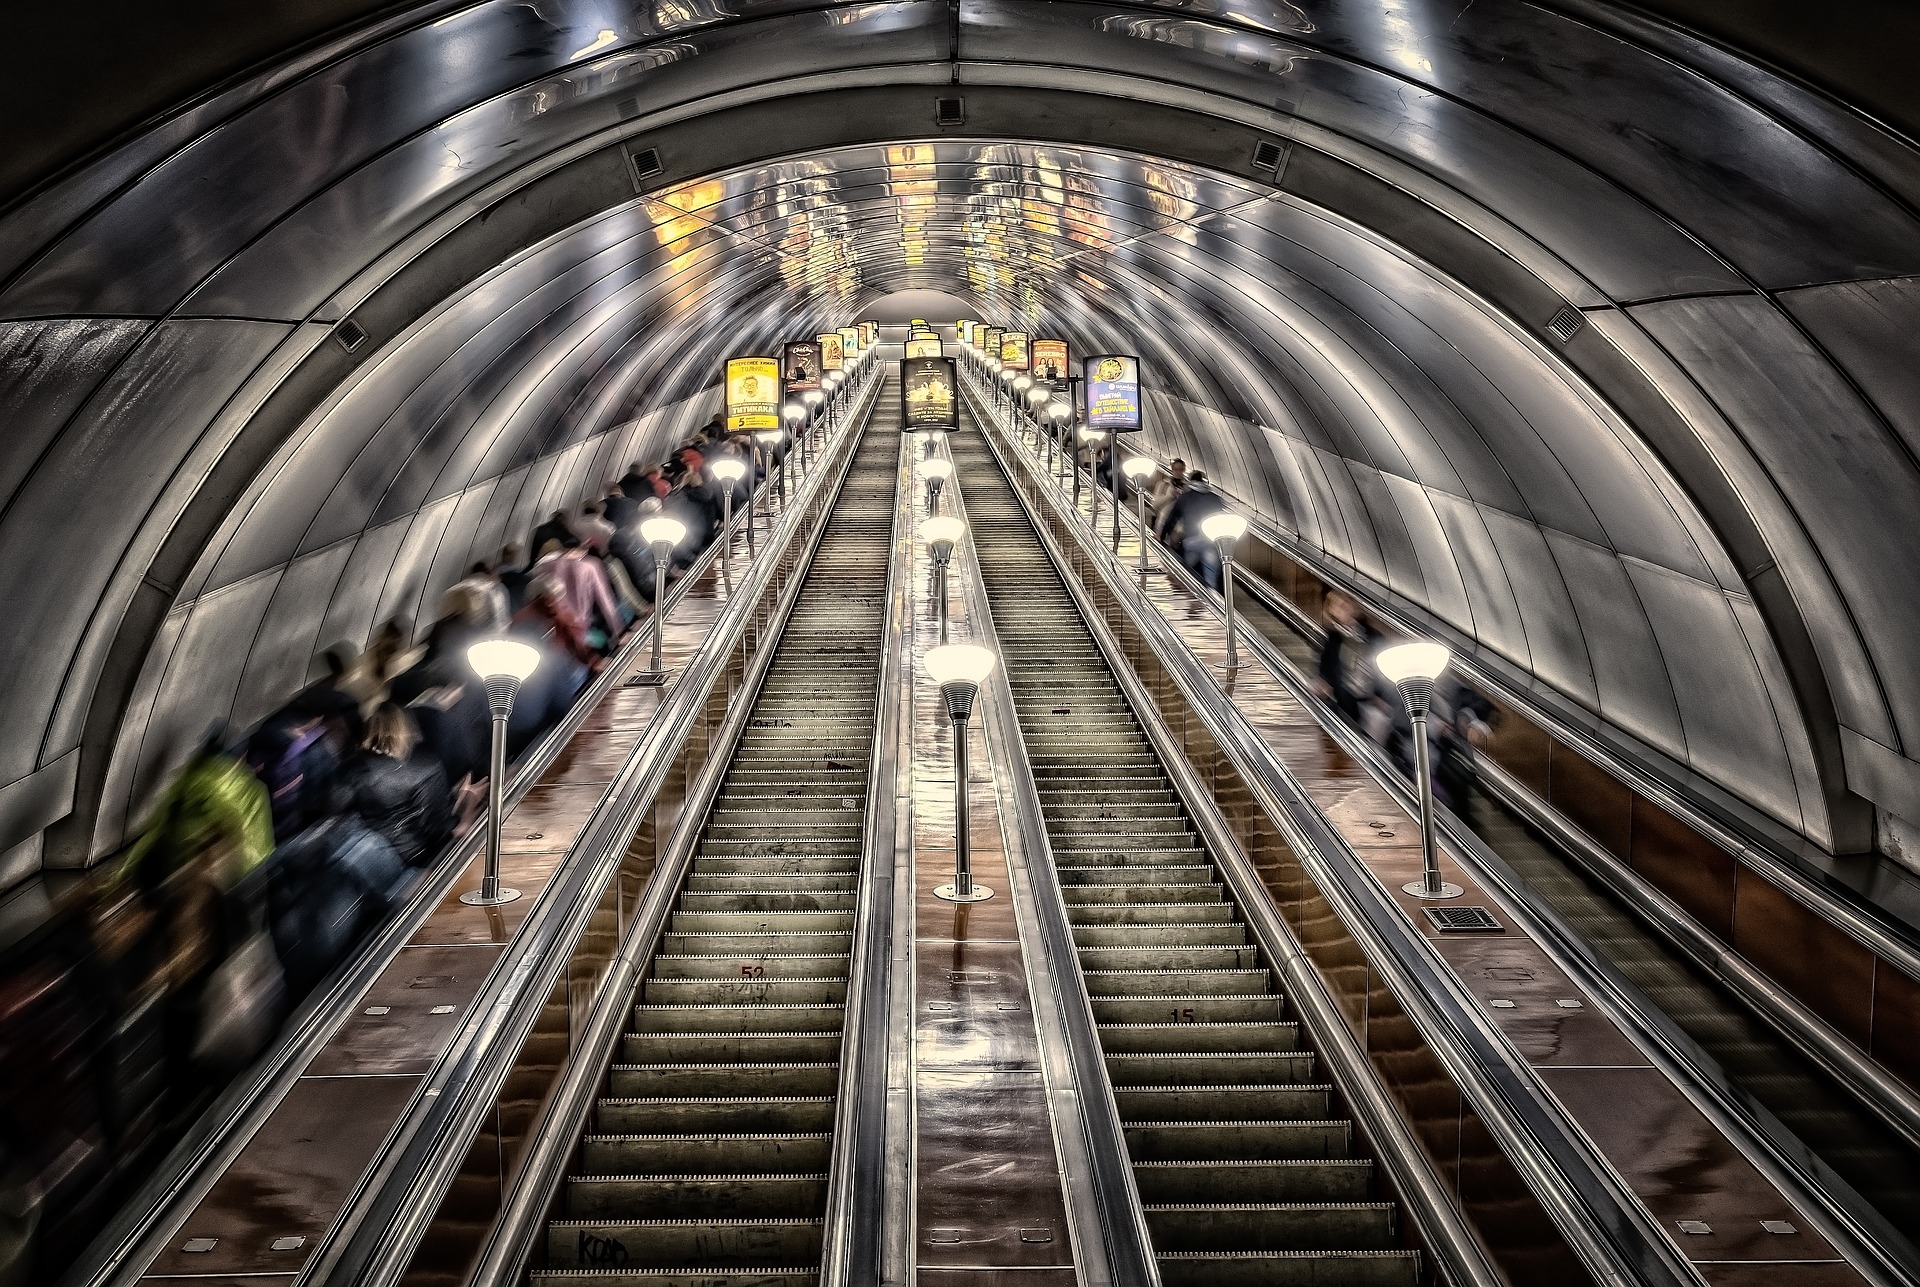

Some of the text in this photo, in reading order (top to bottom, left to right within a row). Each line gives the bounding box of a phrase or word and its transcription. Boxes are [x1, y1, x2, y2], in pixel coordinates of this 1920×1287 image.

[732, 406, 774, 414] ТИТИКАКА
[741, 966, 765, 978] 52
[1170, 1008, 1194, 1023] 15
